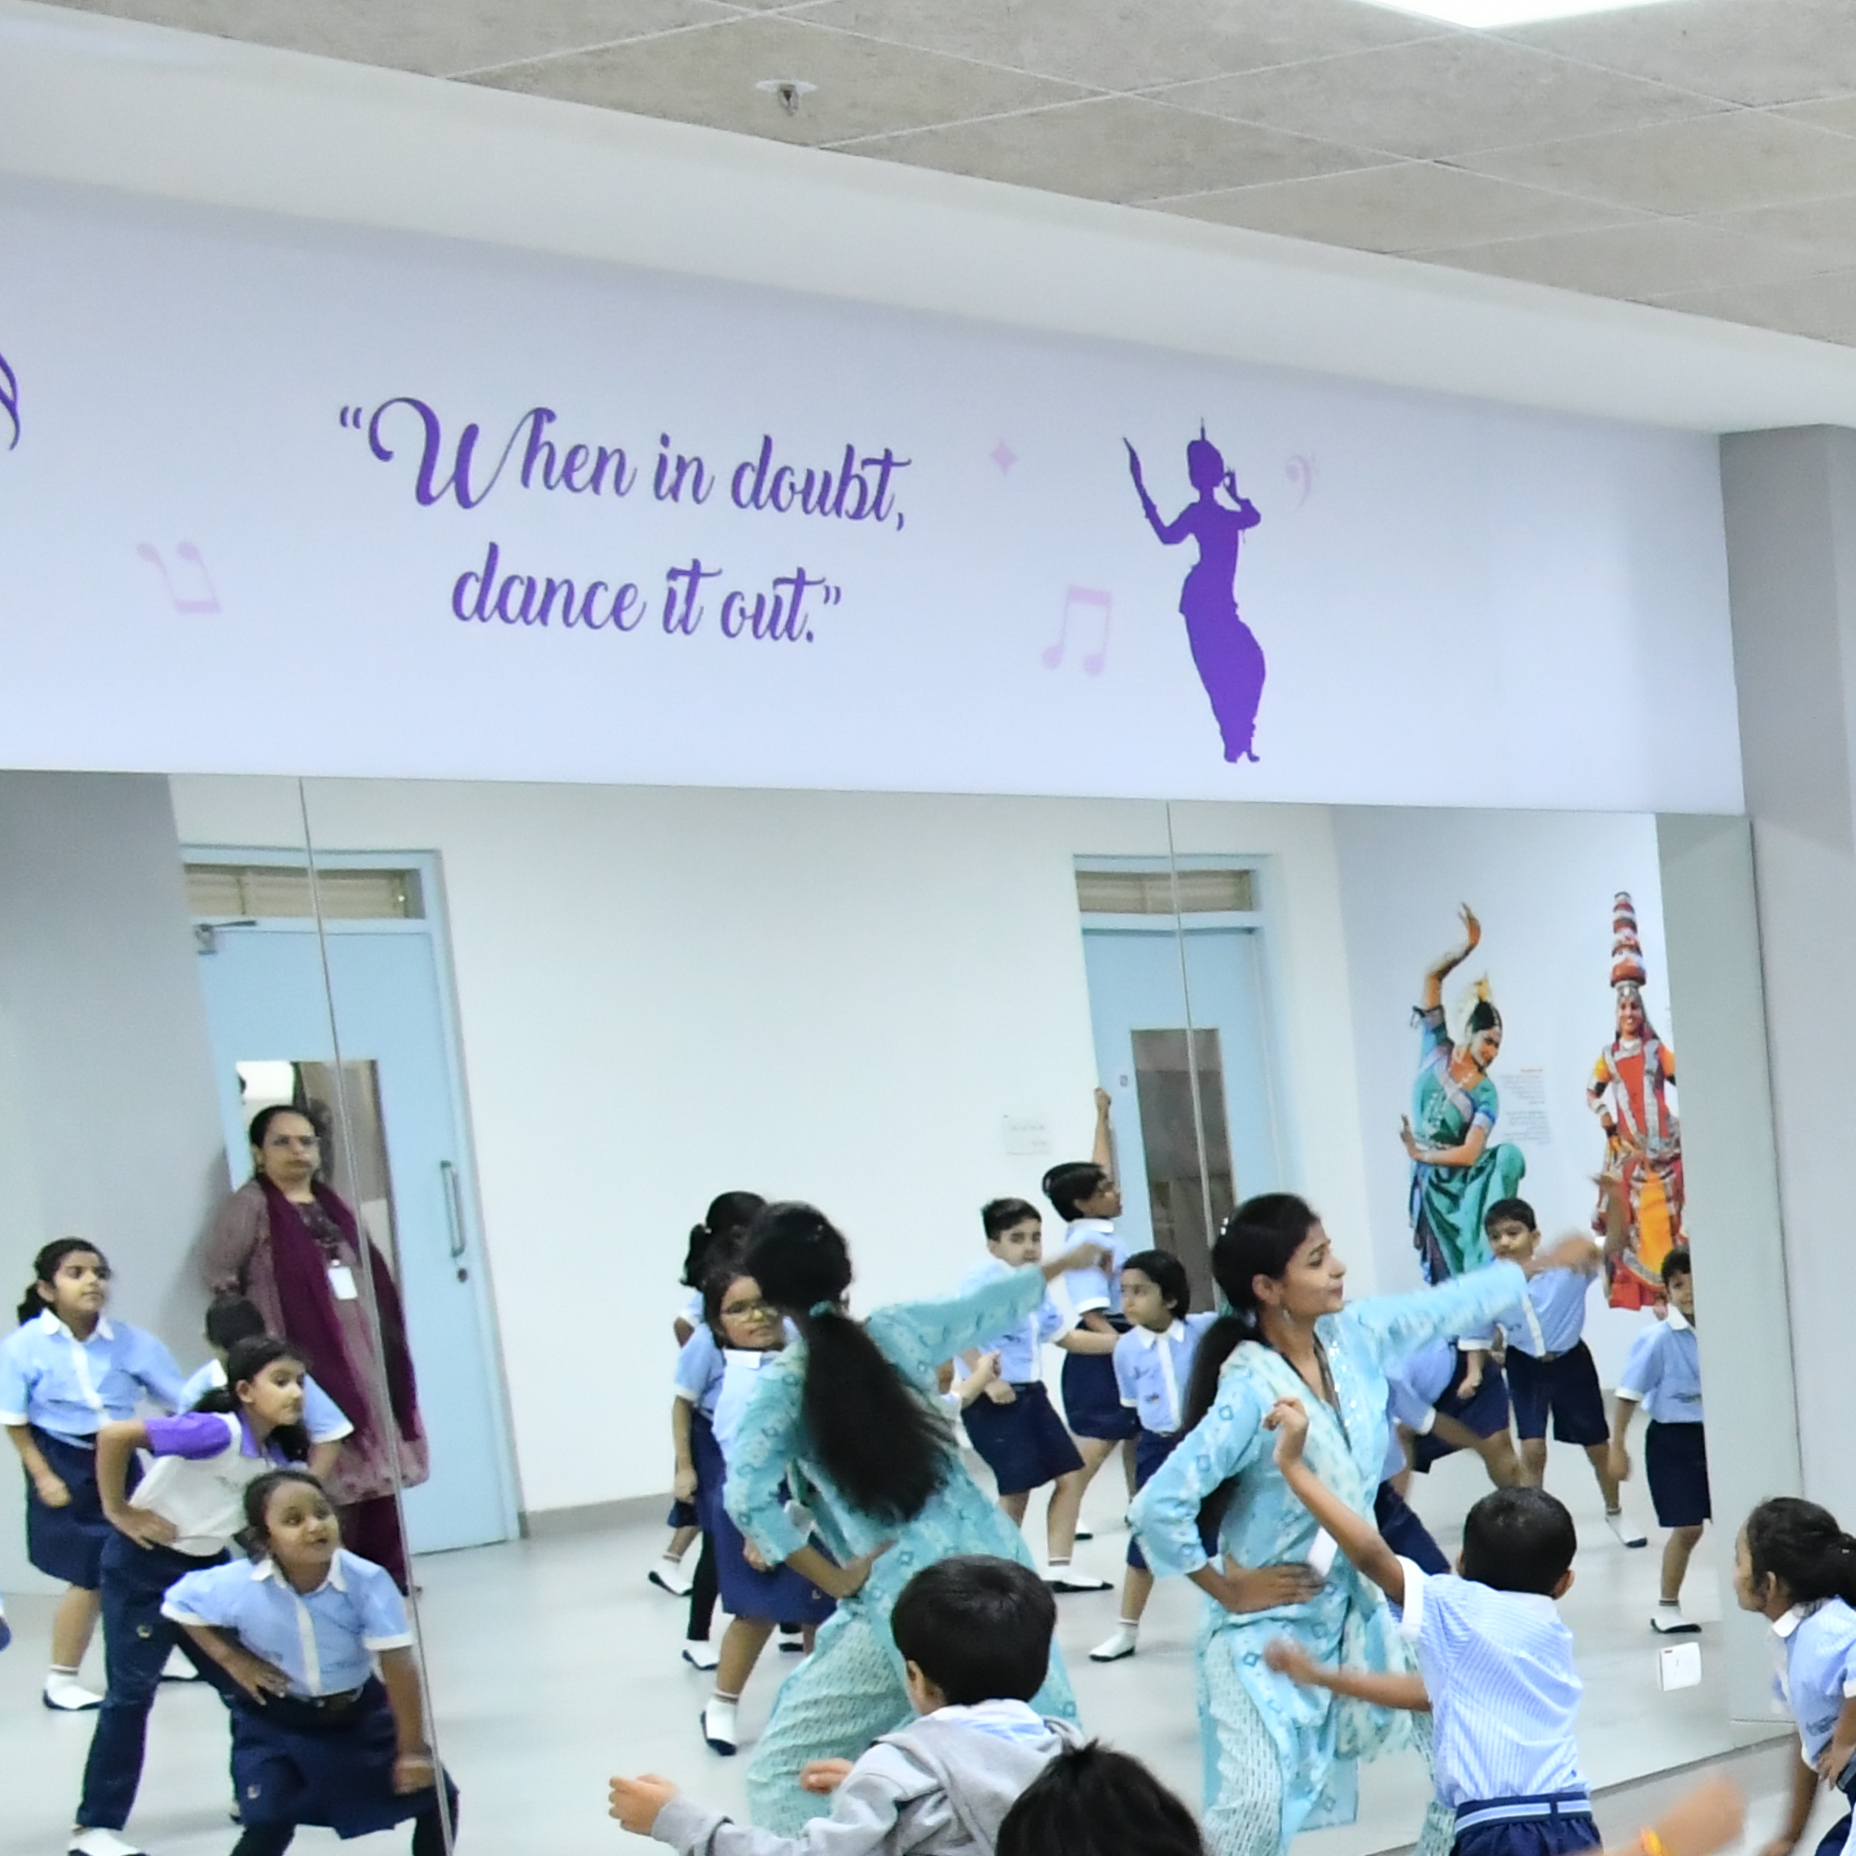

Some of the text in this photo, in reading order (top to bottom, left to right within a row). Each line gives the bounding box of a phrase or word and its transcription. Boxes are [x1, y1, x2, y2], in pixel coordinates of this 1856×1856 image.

[653, 433, 714, 504] in
[731, 434, 912, 531] doubt,
[452, 542, 646, 631] dance
[663, 558, 723, 637] it
